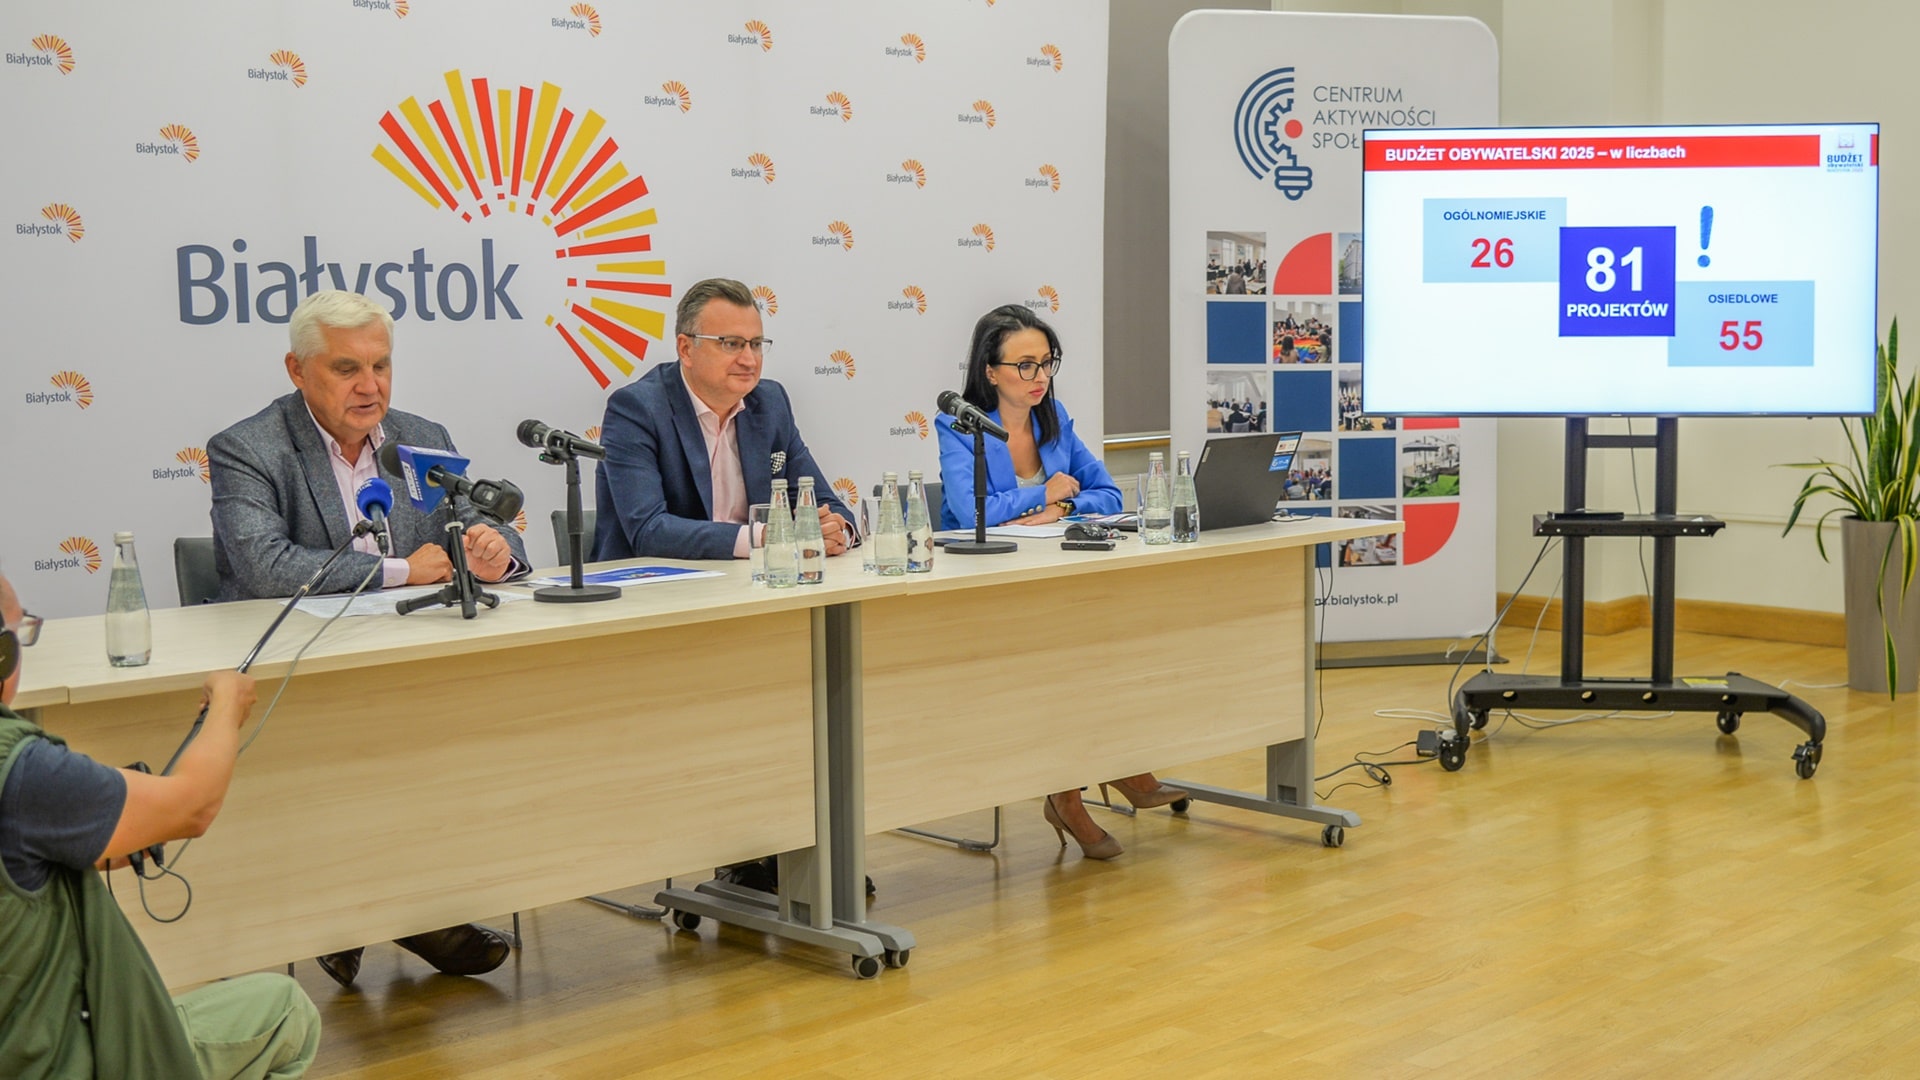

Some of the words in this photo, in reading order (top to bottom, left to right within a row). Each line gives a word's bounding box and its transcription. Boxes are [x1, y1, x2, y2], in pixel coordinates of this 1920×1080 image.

[551, 17, 585, 29] Białystok
[727, 34, 758, 46] Białystok
[5, 51, 53, 67] Białystok
[885, 46, 912, 57] Białystok
[247, 67, 289, 82] Białystok
[644, 95, 676, 107] Białystok
[1313, 86, 1403, 103] CENTRUM
[810, 105, 838, 117] Białystok
[1312, 106, 1436, 126] AKTYWNOŚCI
[1312, 132, 1360, 149] SPOŁ
[135, 140, 180, 157] Białystok
[1385, 145, 1446, 161] BUDŻET
[1449, 146, 1557, 160] OBYWATELSKI
[1560, 146, 1594, 160] 2025
[1610, 149, 1622, 159] w
[1626, 145, 1686, 159] liczbach
[1827, 152, 1863, 162] BUDŻET
[731, 167, 761, 179] Białystok
[886, 173, 913, 184] Białystok
[1443, 209, 1546, 220] OGÓLNOMIEJSKIE
[15, 221, 63, 238] Białystok
[812, 235, 840, 247] Białystok
[1470, 238, 1514, 268] 26
[1585, 246, 1643, 292] 81
[888, 300, 914, 311] Białystok
[1708, 294, 1778, 303] OSIEDLOWE
[1566, 300, 1669, 317] PROJEKTÓW
[1719, 321, 1763, 351] 55
[814, 365, 842, 377] Białystok
[26, 389, 72, 406] Białystok
[152, 465, 196, 481] Białystok
[35, 557, 80, 573] Białystok
